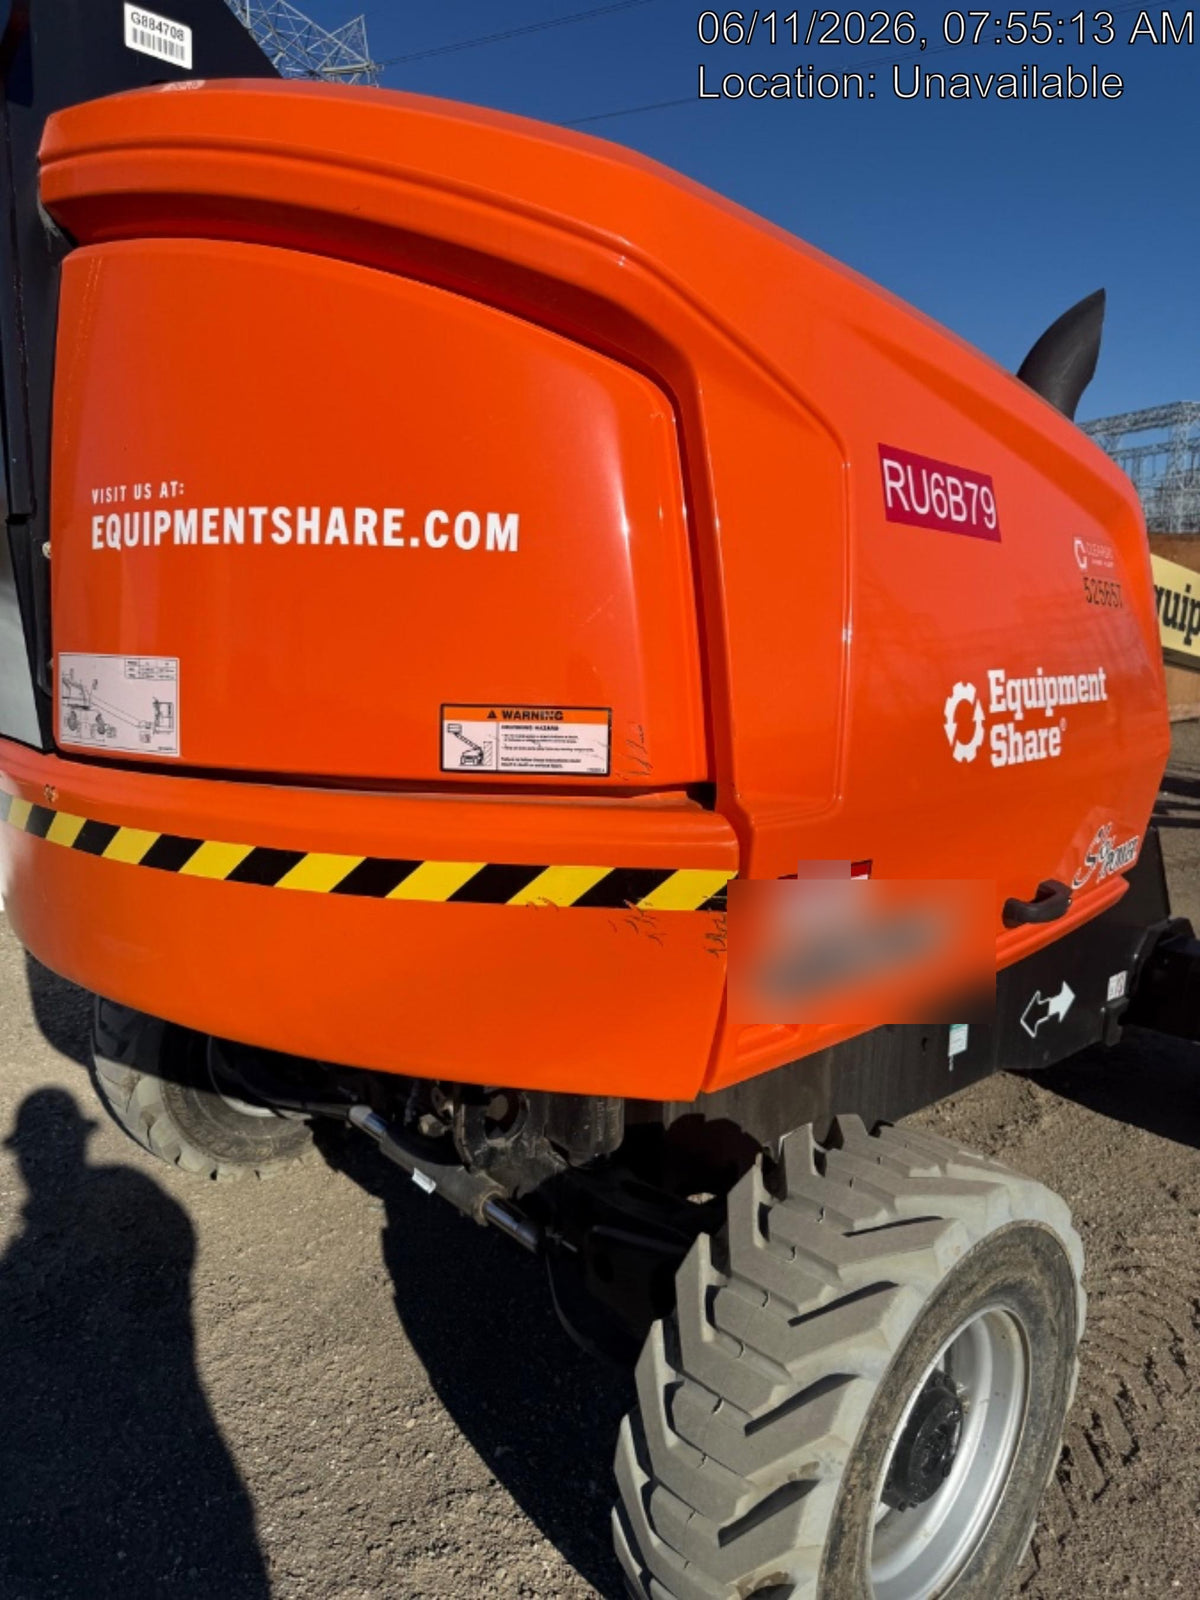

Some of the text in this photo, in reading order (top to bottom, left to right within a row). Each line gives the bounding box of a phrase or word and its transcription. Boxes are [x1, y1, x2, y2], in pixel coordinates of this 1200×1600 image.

[130, 11, 184, 42] G884708
[91, 480, 185, 504] VISIT US AT:
[882, 458, 997, 530] RU6B79
[91, 506, 520, 552] EQUIPMENTSHARE.COM
[987, 666, 1108, 720] Equipment
[501, 710, 564, 721] WARNING
